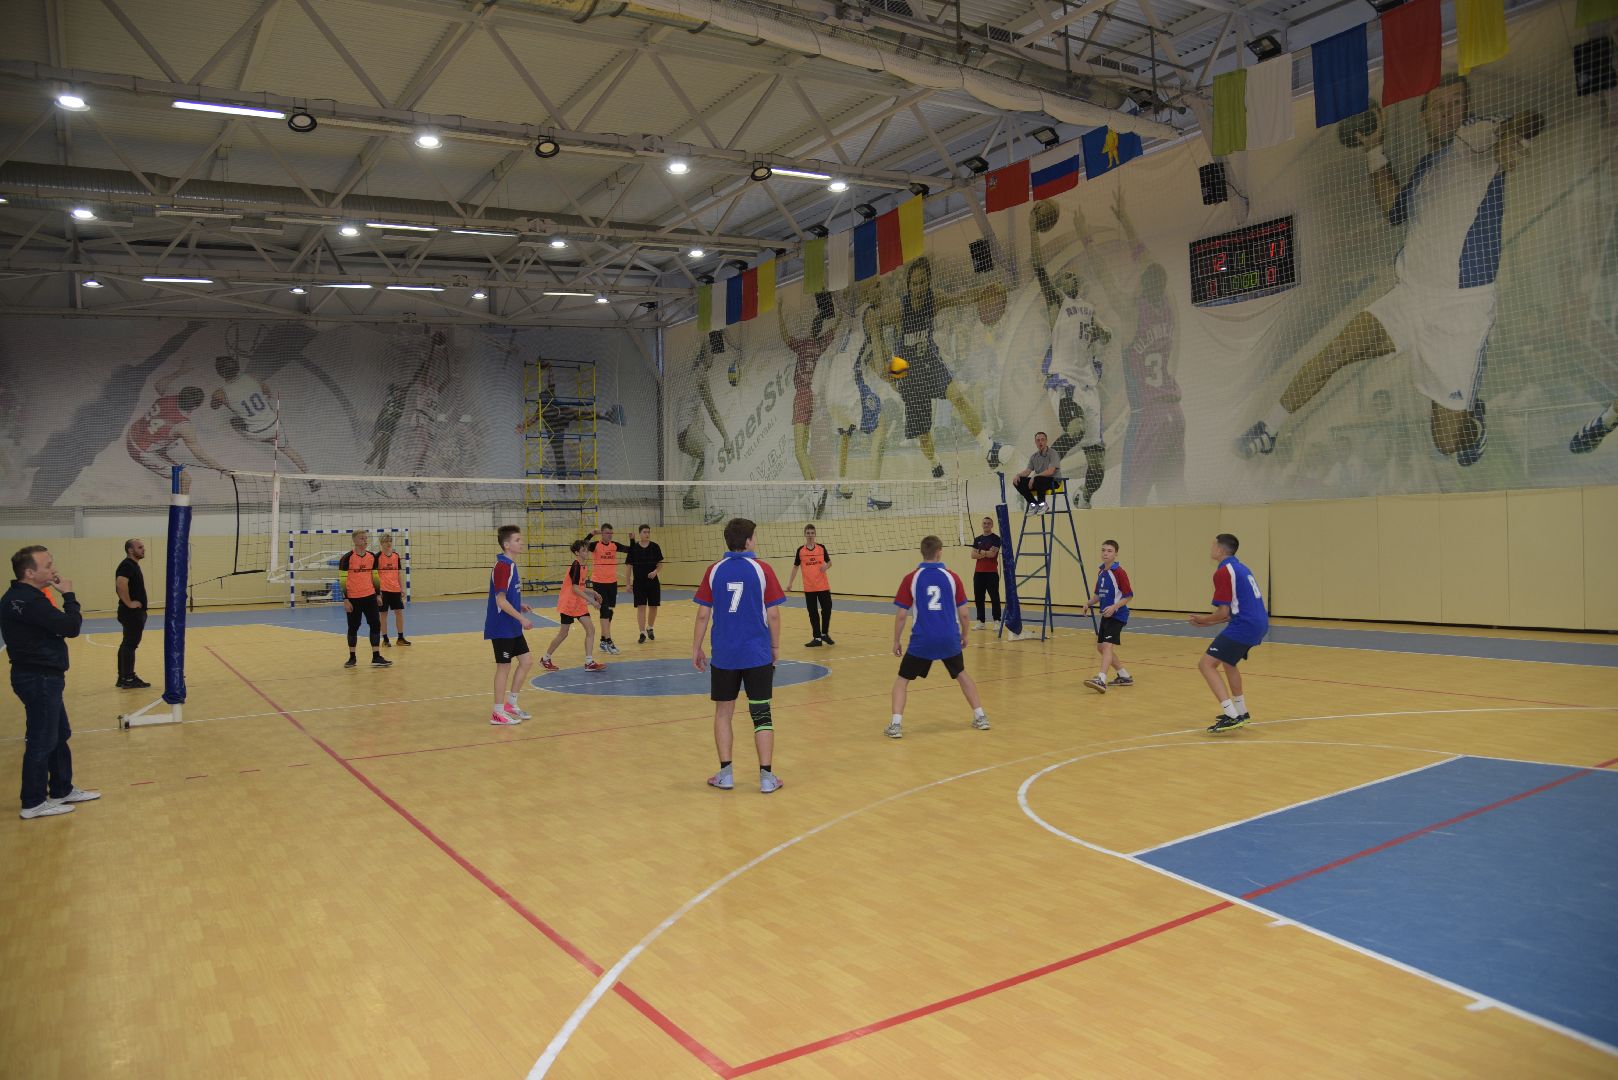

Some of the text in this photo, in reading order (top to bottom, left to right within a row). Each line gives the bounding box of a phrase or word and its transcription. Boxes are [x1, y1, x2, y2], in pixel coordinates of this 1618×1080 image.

[1269, 239, 1285, 258] 11
[1144, 352, 1163, 387] 3
[240, 392, 266, 417] 10
[726, 581, 744, 613] 7
[926, 585, 942, 611] 2
[1247, 574, 1262, 598] 8
